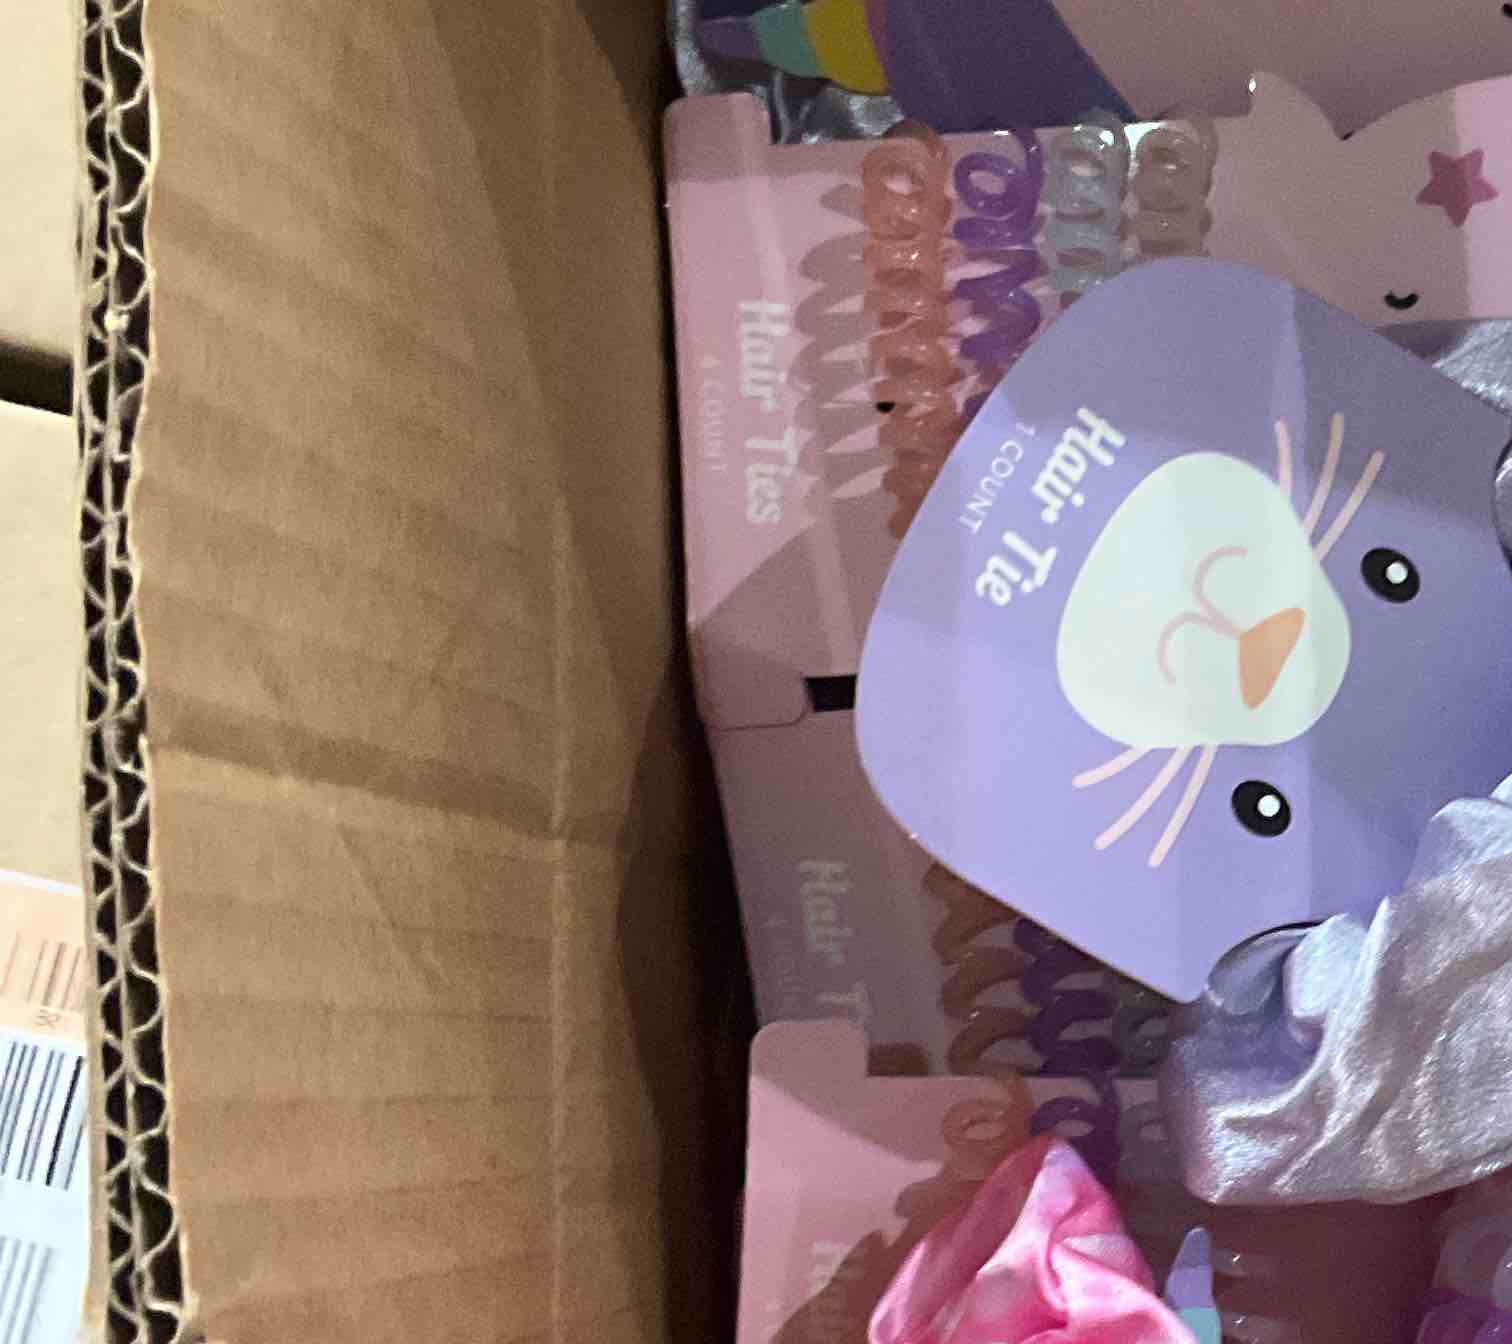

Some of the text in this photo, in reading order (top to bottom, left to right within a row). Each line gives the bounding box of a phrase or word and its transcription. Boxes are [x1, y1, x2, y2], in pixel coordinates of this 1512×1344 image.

[738, 301, 800, 525] Hair Ties
[959, 421, 1037, 536] 1 COUNT
[975, 406, 1127, 606] Hair Tie
